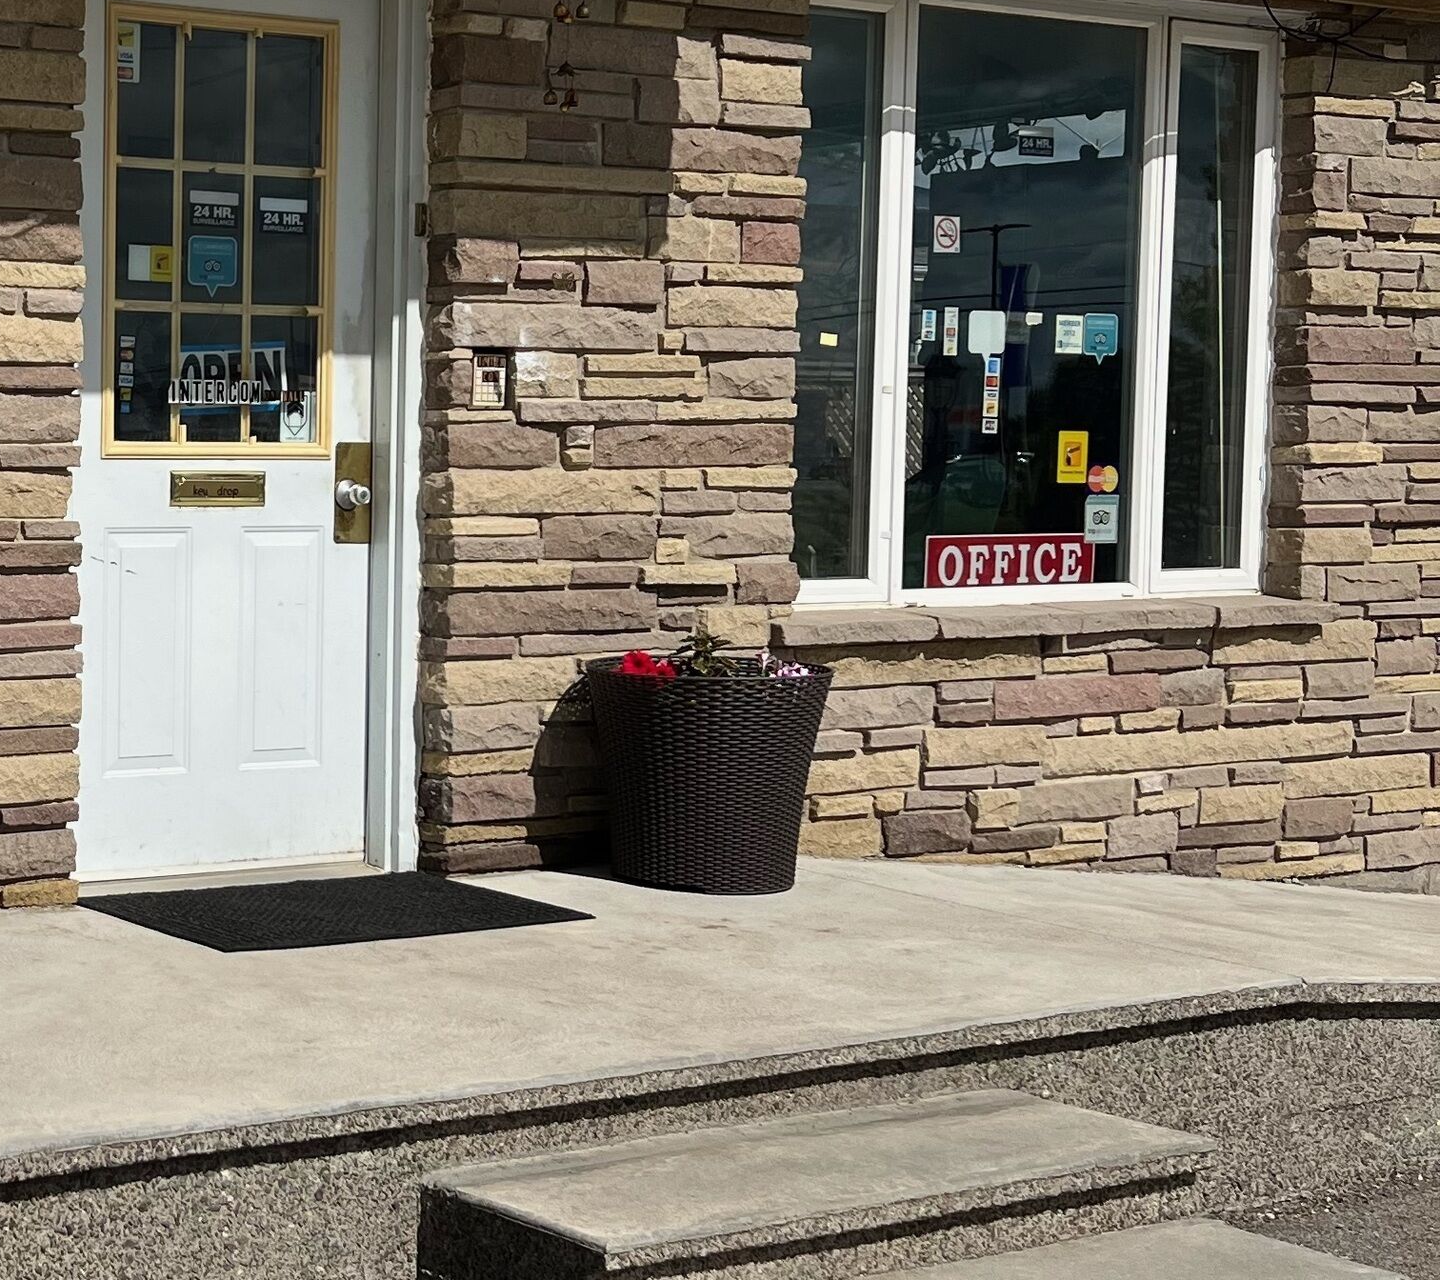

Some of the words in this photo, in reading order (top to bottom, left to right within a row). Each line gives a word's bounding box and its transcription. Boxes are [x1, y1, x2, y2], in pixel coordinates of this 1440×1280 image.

[1022, 137, 1034, 148] 24
[193, 205, 210, 217] 24
[213, 206, 235, 219] HR.
[263, 212, 280, 224] 24
[283, 213, 304, 226] HR.
[171, 380, 260, 404] INTERCOM
[216, 485, 239, 498] drop
[937, 542, 1083, 587] OFFICE
